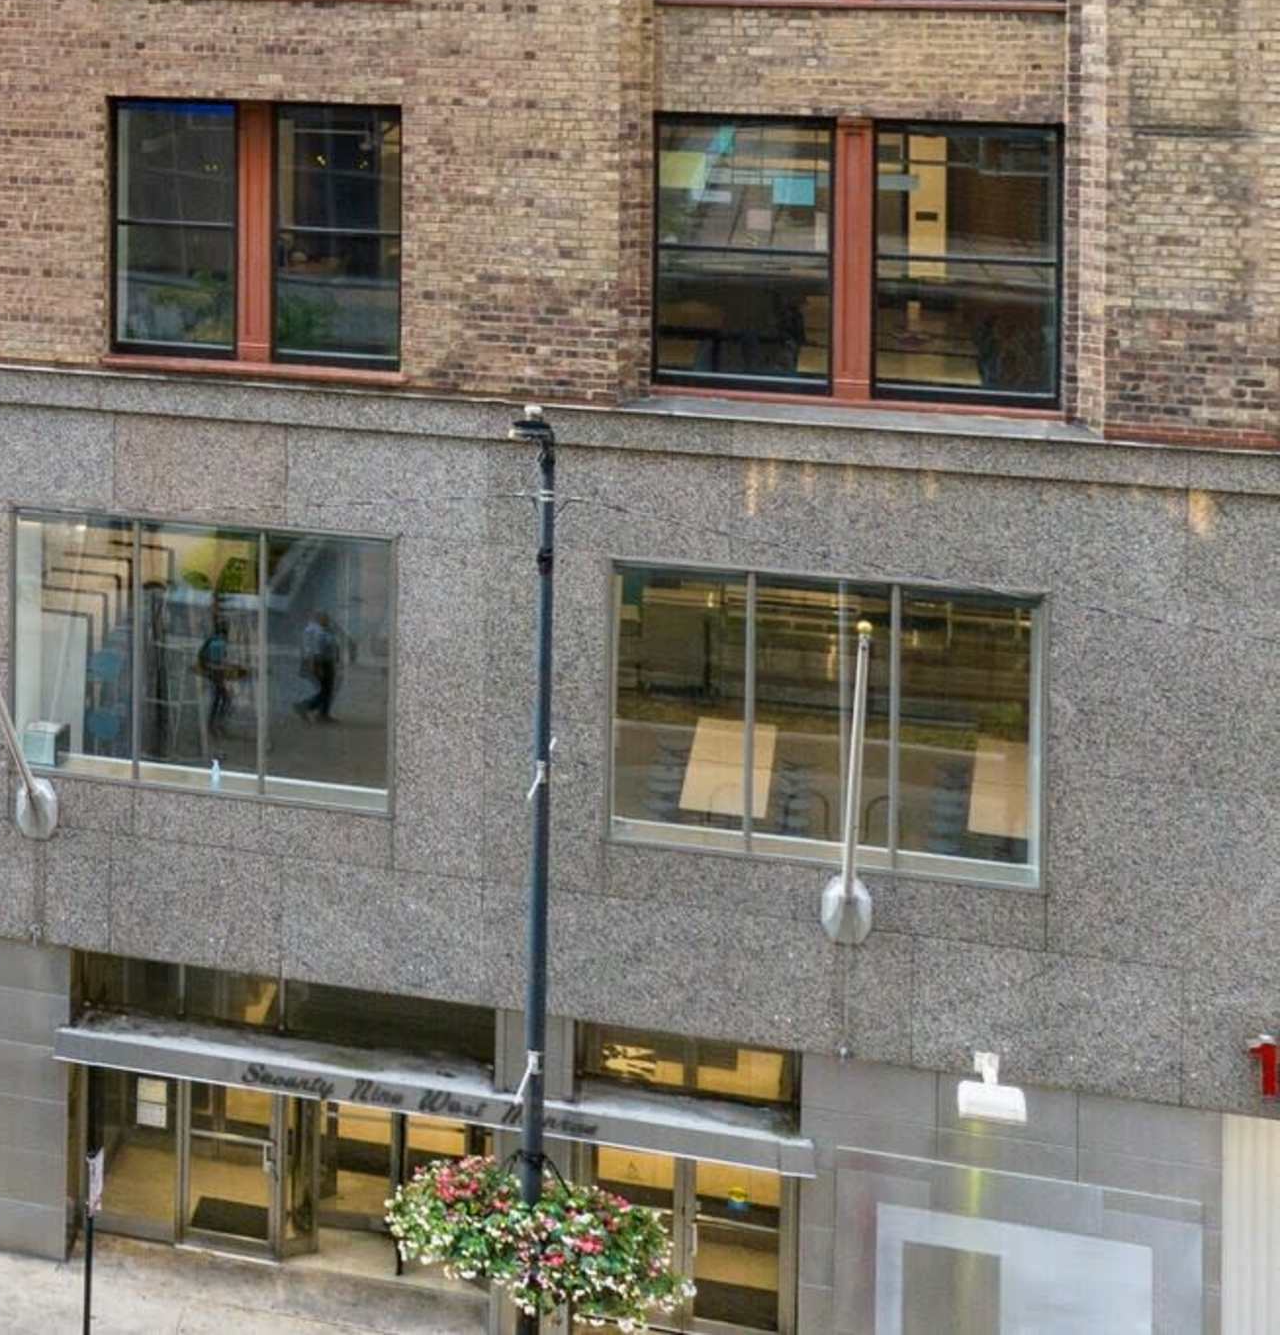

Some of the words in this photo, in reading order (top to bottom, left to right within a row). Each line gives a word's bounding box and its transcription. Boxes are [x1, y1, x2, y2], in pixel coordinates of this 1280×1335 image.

[349, 1077, 404, 1106] Nine
[418, 1088, 485, 1118] West
[500, 1104, 598, 1137] Mnroe
